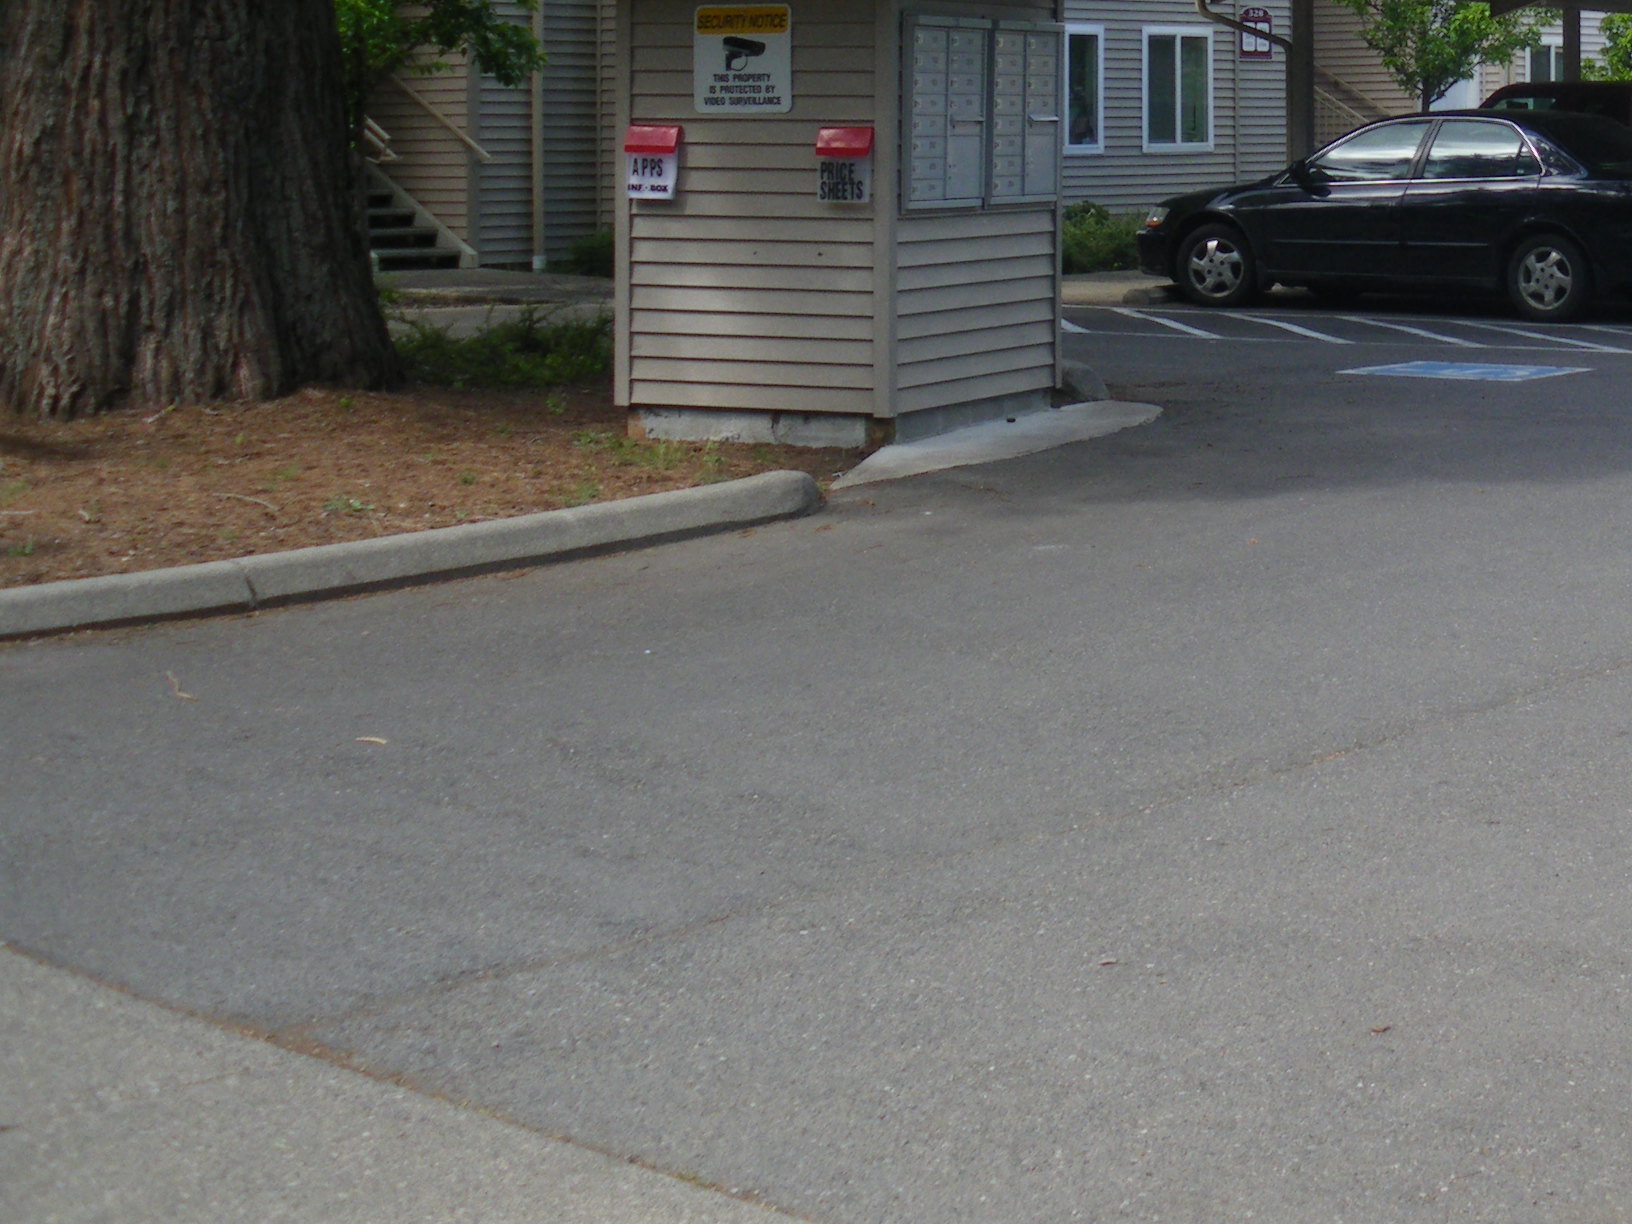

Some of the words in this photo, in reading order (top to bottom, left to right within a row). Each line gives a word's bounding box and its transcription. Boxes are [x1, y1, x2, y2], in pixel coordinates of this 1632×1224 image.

[697, 14, 746, 30] SECURITY
[749, 12, 788, 28] NOTICE
[713, 73, 730, 83] THIS
[732, 73, 771, 83] PROPERTY
[709, 85, 717, 94] IS
[720, 84, 762, 94] PROTECTED
[765, 84, 776, 94] BY
[703, 96, 726, 106] VIDEO
[728, 96, 782, 106] SURVEILLANCE
[632, 157, 664, 177] APPS
[820, 161, 855, 181] PRICE
[820, 180, 864, 201] SHEETS
